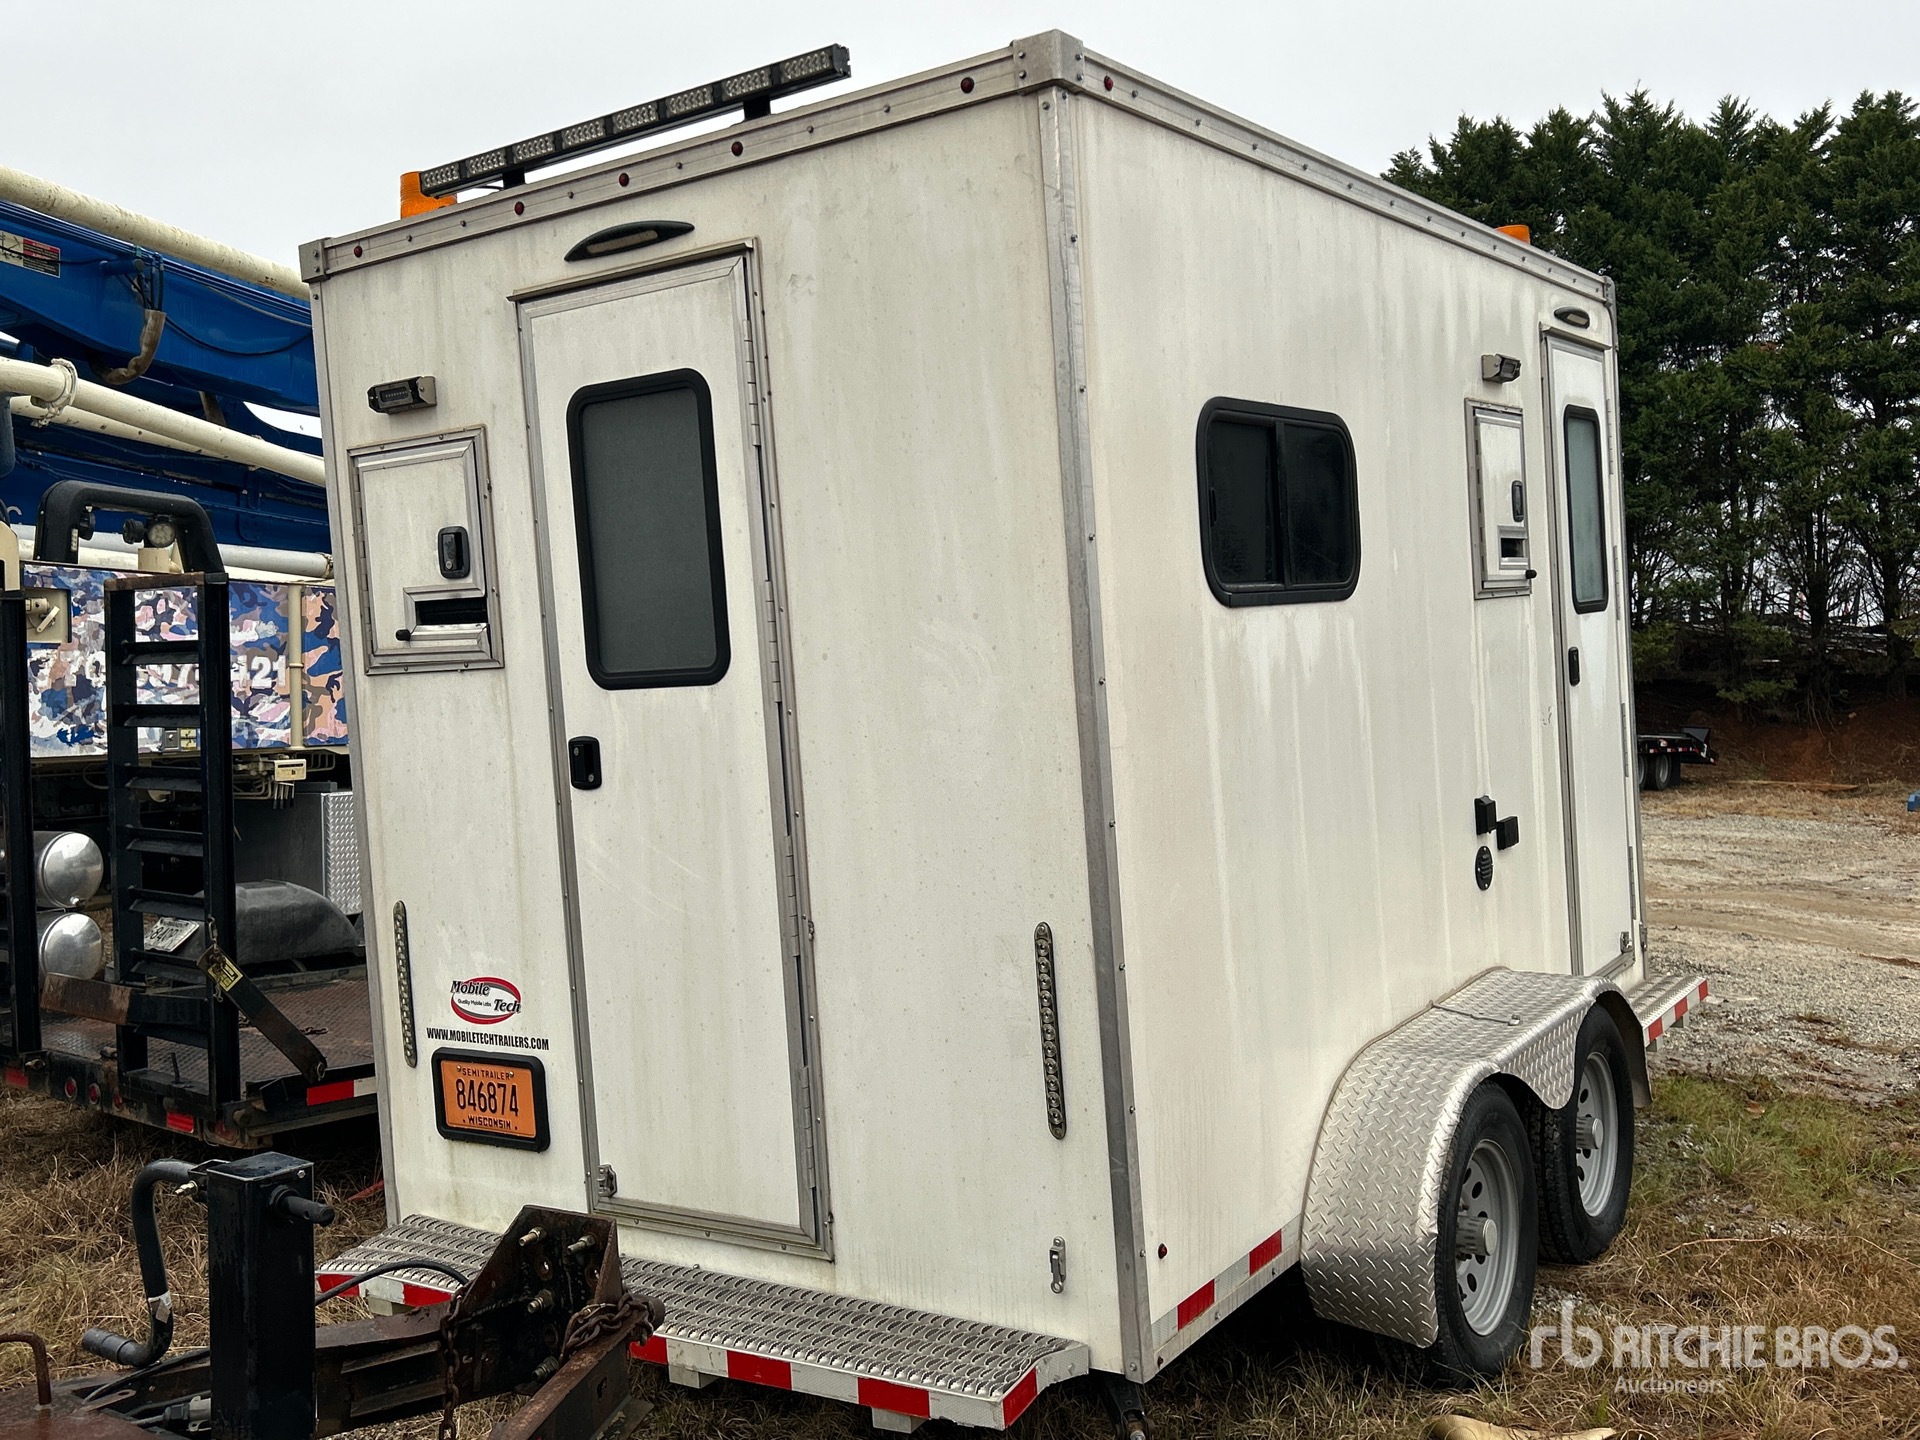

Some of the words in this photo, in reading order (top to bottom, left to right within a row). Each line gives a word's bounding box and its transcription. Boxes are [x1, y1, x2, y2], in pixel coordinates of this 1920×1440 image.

[450, 980, 490, 996] Mobile
[457, 998, 471, 1006] Quality
[493, 998, 521, 1013] Tech
[426, 1027, 549, 1050] WWW.MOBILETECHTRAILERS.COM
[455, 1078, 518, 1117] 846874
[468, 1114, 511, 1130] WISCONSIN
